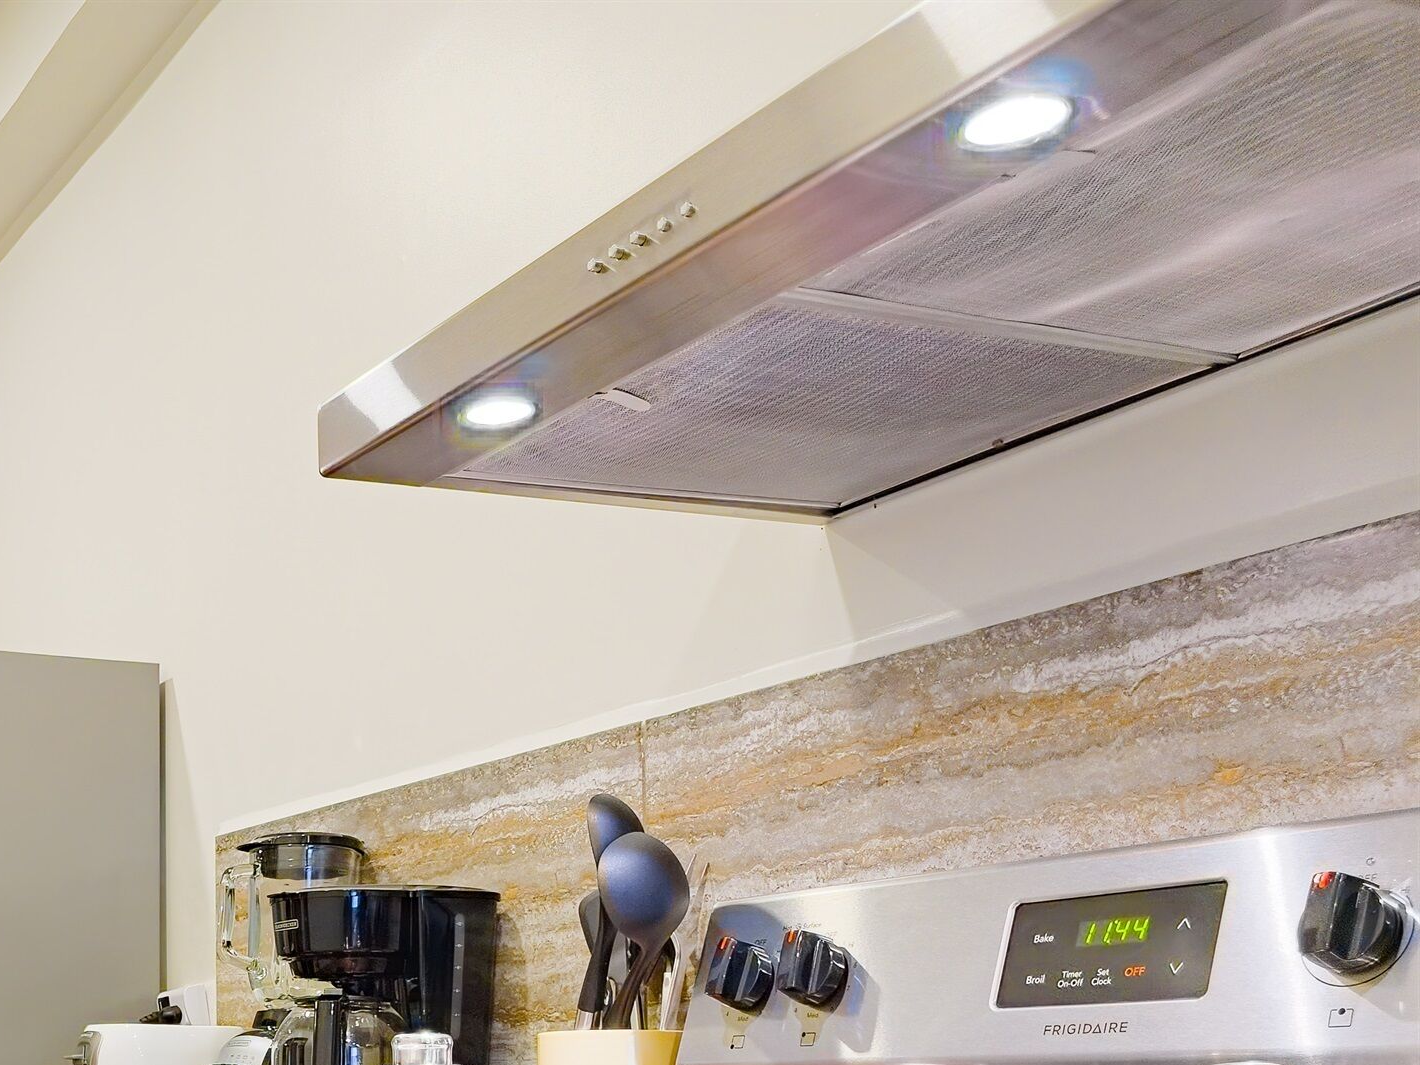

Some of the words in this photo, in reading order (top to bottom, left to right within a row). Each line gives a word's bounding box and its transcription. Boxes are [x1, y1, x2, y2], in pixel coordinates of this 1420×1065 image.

[1033, 933, 1055, 944] Bake
[1061, 970, 1083, 979] Timer
[1096, 968, 1110, 976] Set
[1124, 966, 1146, 977] OFF
[1025, 974, 1046, 985] Broil
[1057, 978, 1084, 988] On-Off
[1091, 977, 1112, 986] Clock
[1043, 1021, 1129, 1036] FRIGIDAIRE
